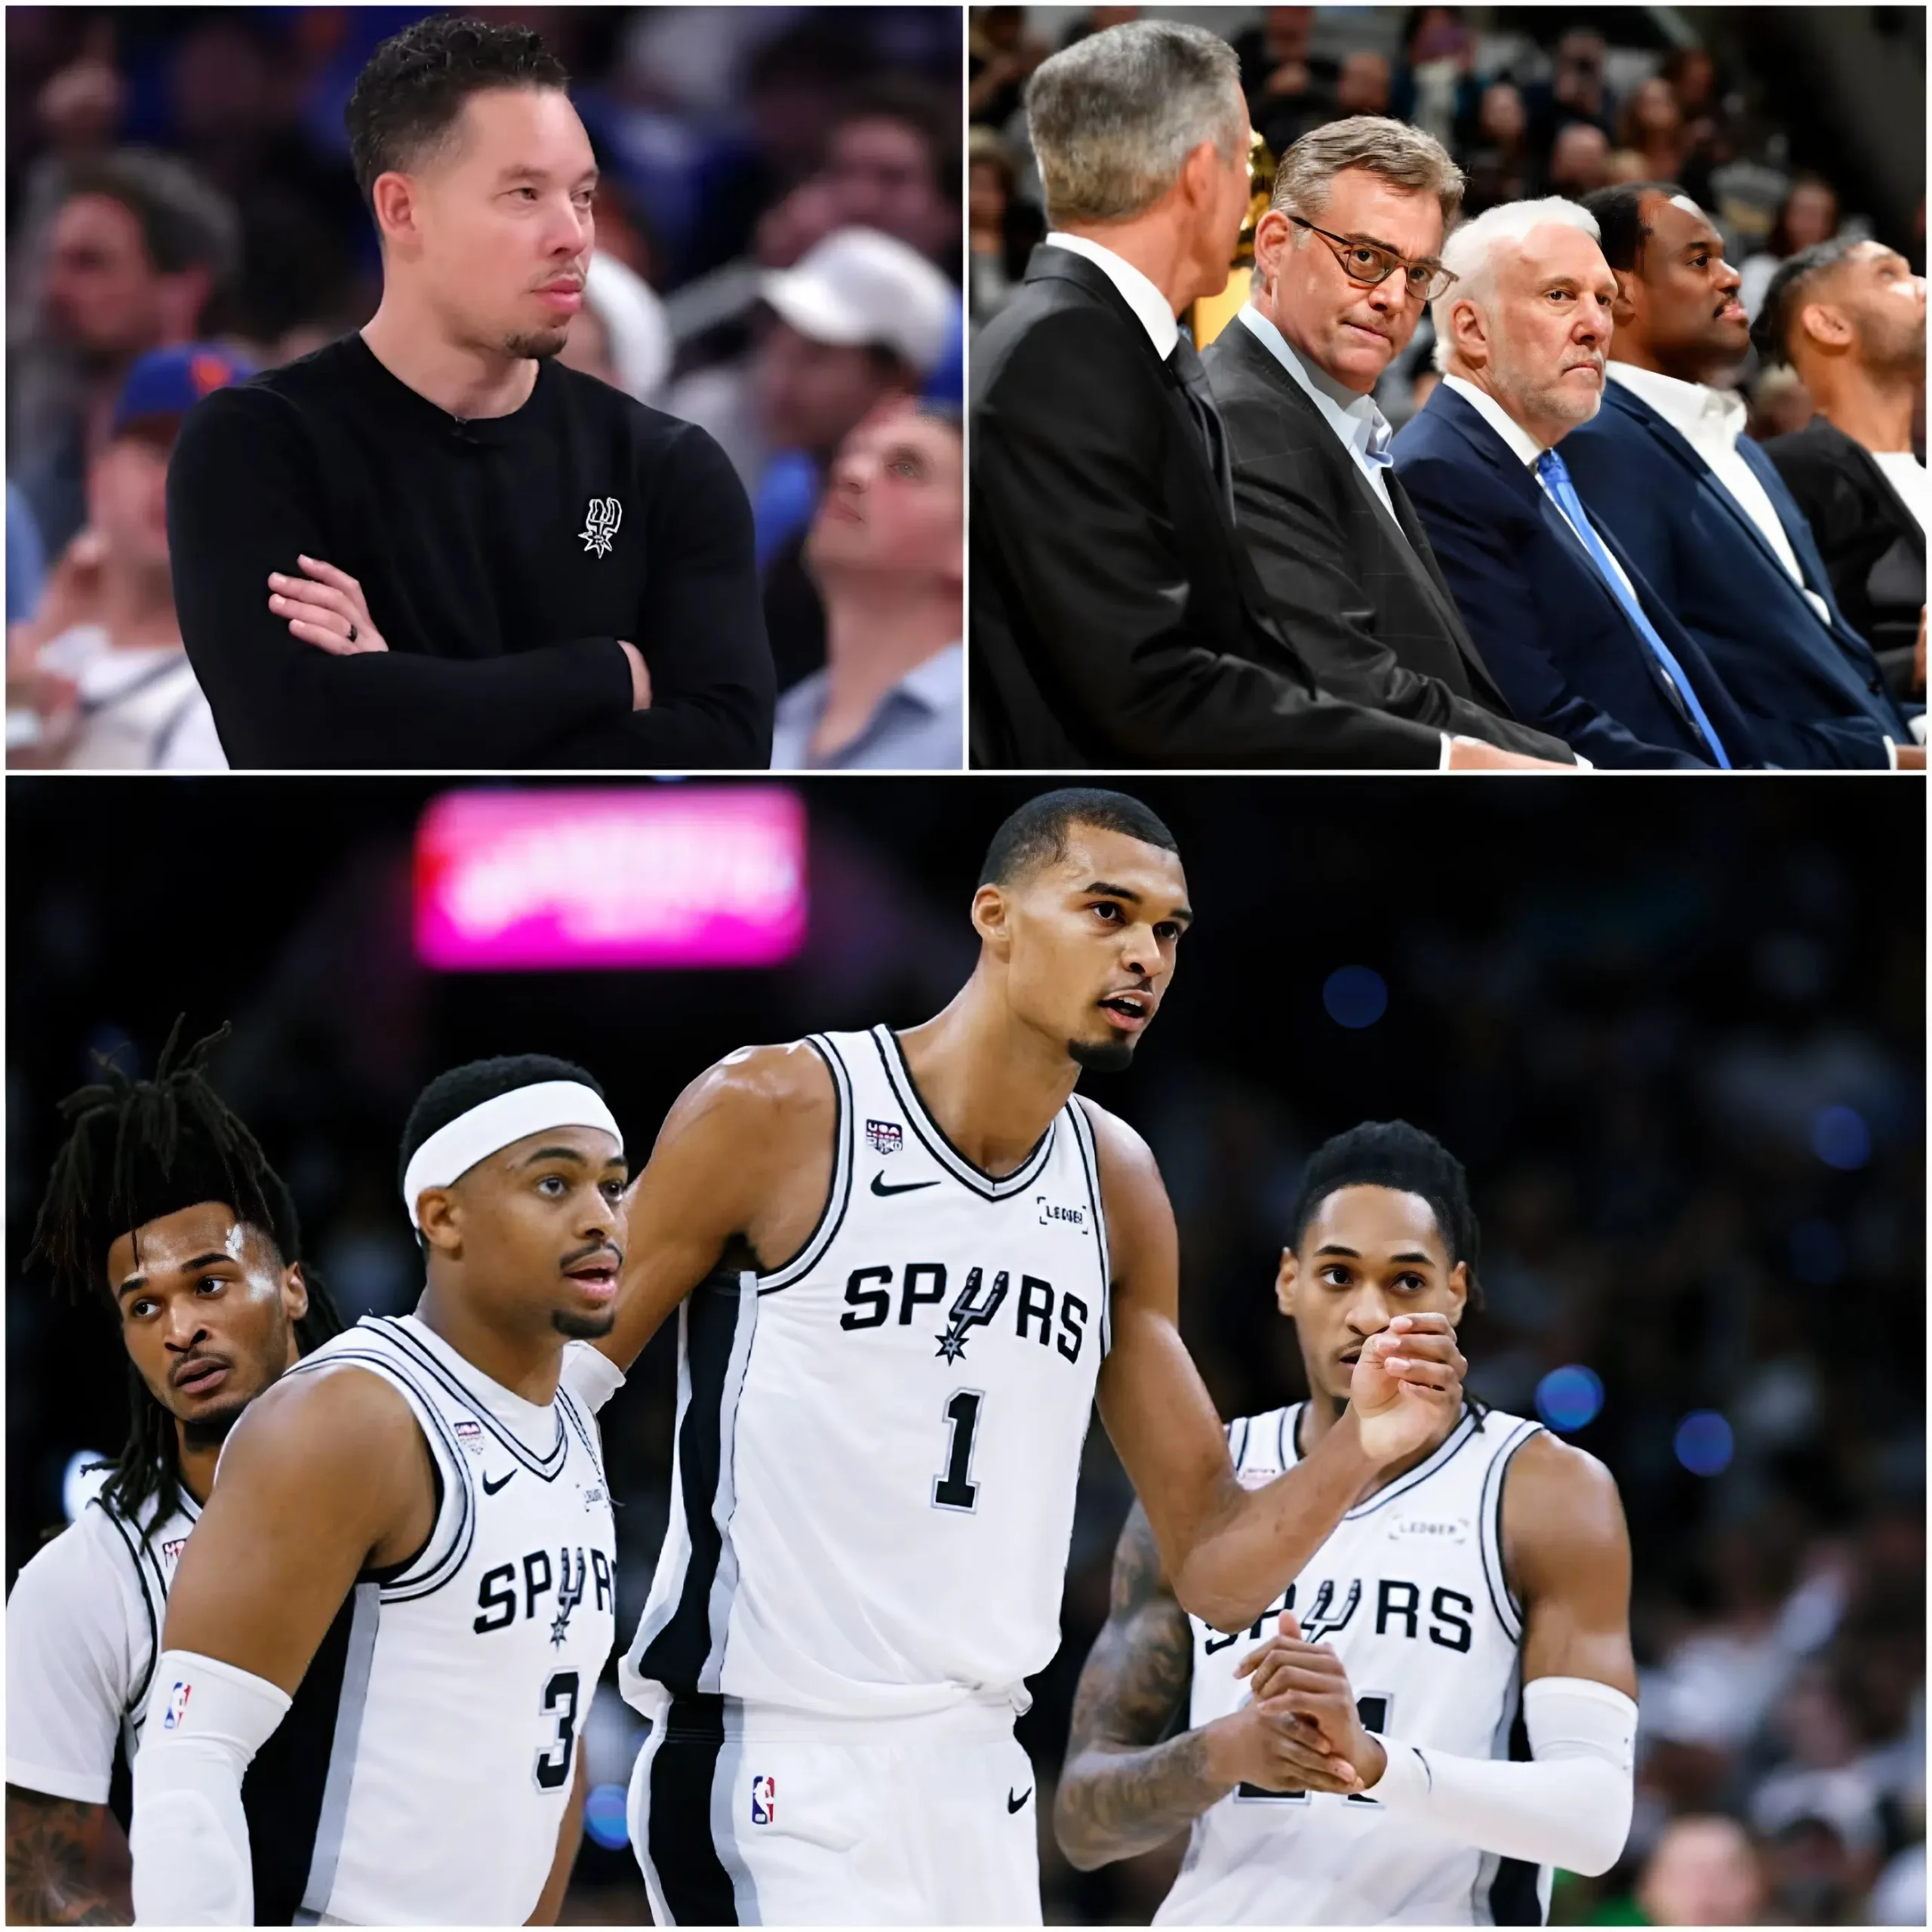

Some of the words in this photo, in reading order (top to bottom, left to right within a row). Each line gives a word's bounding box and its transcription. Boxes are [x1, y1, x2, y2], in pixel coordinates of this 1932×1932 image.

[840, 1263, 1088, 1366] SPURS
[931, 1387, 986, 1515] 1
[473, 1546, 617, 1652] SPUR
[531, 1666, 580, 1795] 3
